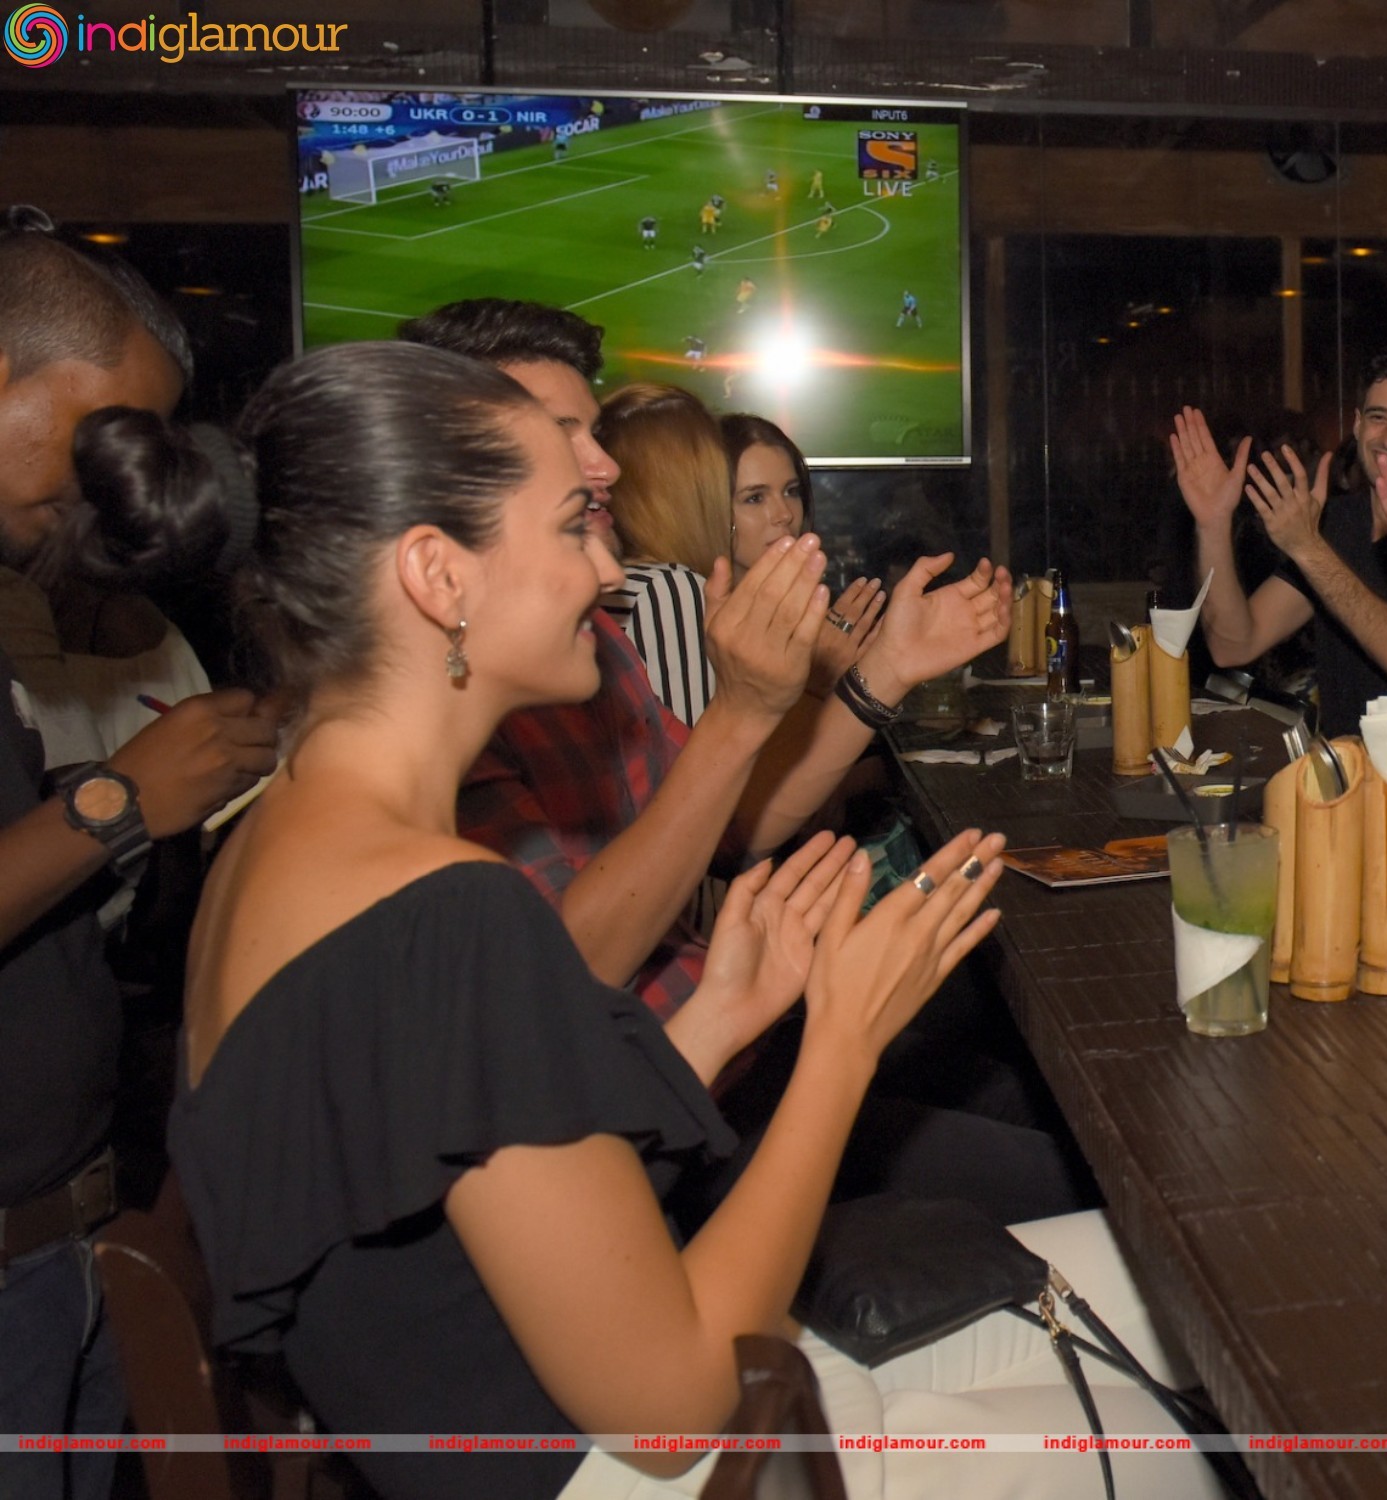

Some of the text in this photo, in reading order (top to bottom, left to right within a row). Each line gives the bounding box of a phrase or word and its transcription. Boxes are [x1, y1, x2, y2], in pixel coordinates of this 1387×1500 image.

[330, 107, 381, 117] 90:00
[409, 108, 448, 120] UKR
[516, 112, 548, 122] NIR
[332, 124, 396, 135] 1:48 +6
[859, 132, 914, 140] SONY
[863, 170, 912, 179] SIX
[864, 181, 913, 197] LIVE
